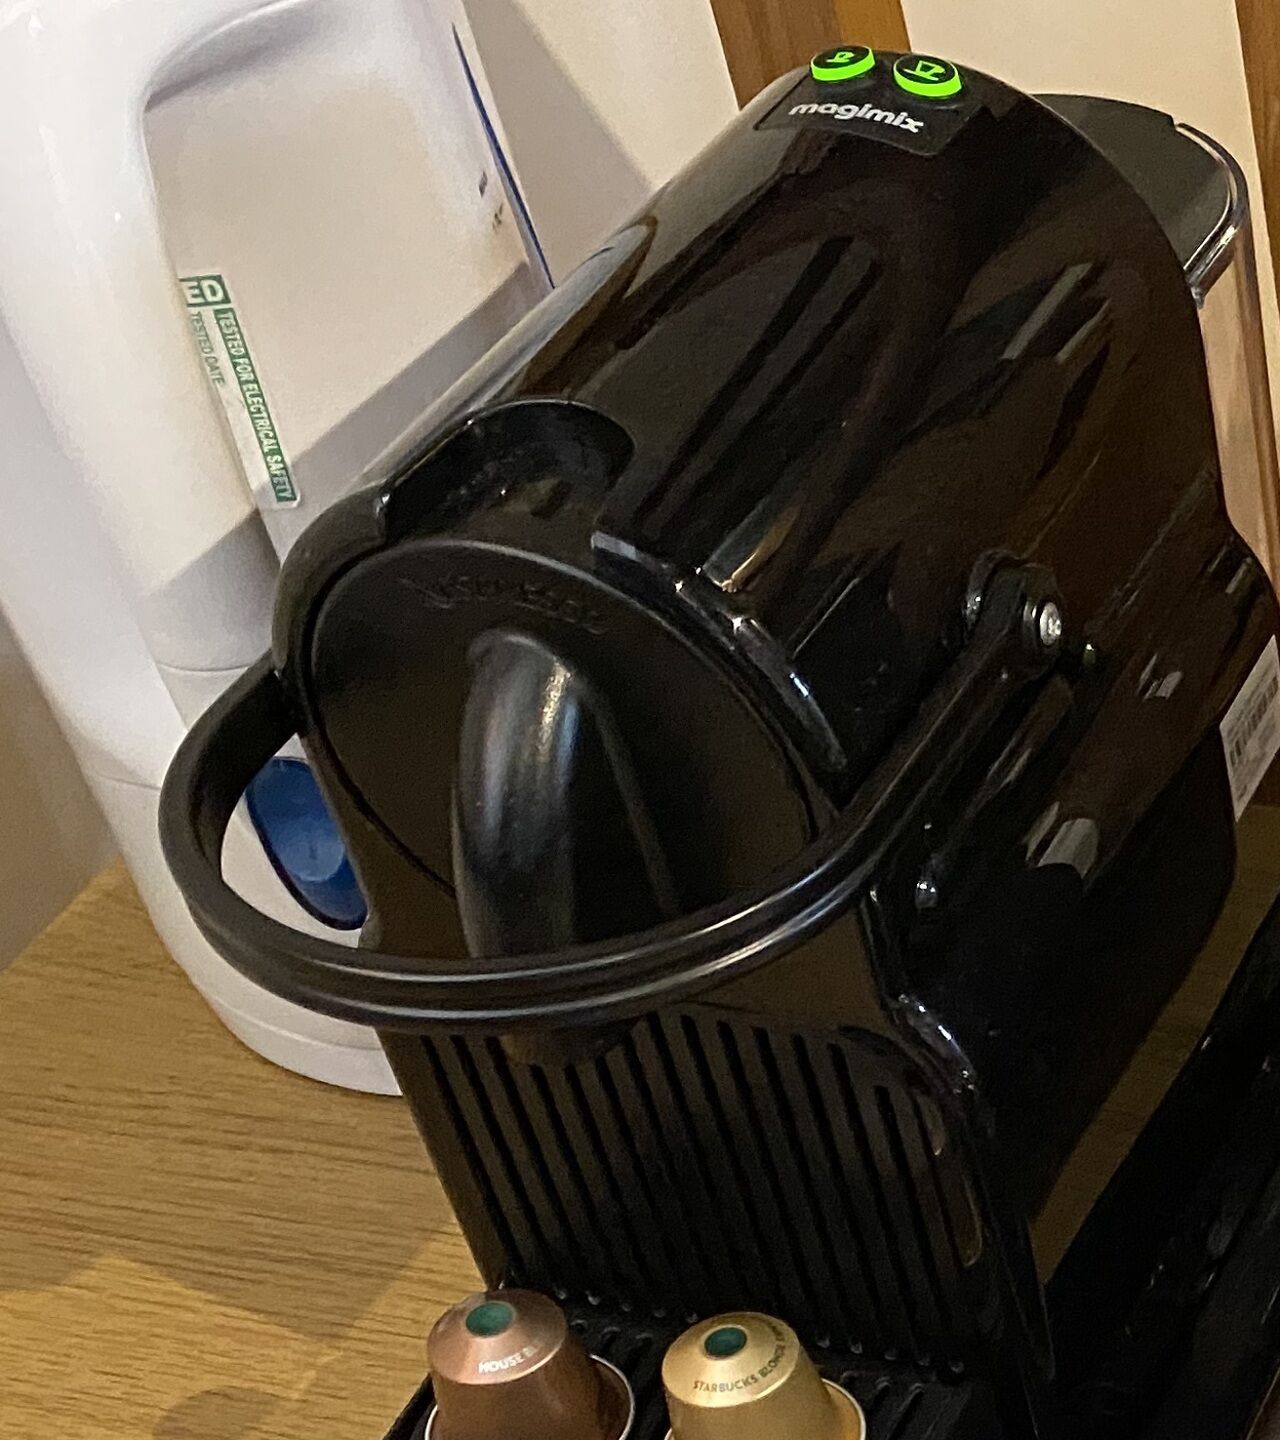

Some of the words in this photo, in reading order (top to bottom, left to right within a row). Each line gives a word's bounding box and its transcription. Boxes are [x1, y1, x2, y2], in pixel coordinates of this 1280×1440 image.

[788, 102, 924, 133] magimix
[217, 311, 246, 356] TESTED
[204, 356, 226, 387] DATE
[233, 357, 258, 382] FOR
[242, 383, 280, 453] ELECTRICAL
[266, 454, 293, 498] SAFETY
[478, 1352, 525, 1375] HOUSE
[693, 1374, 759, 1393] STARBUCKS
